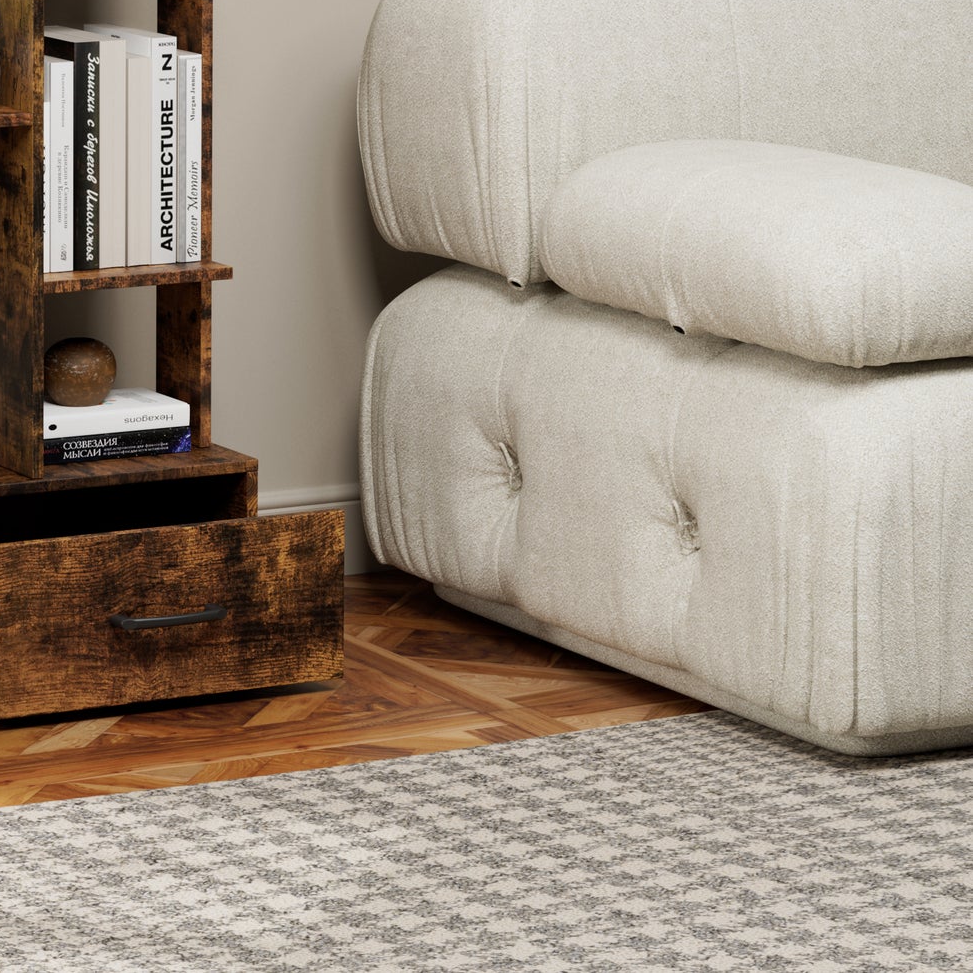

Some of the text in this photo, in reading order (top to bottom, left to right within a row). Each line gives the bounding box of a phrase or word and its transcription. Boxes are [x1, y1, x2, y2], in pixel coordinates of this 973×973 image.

[87, 53, 99, 112] Записки
[83, 133, 97, 183] берегов
[161, 100, 174, 251] ARCHITECTURE
[187, 161, 200, 257] Pioneer Memoirs
[63, 437, 118, 450] СОЗВЕЗДИЯ
[124, 413, 174, 424] Hexagons
[63, 449, 102, 460] МЫСЛИ
